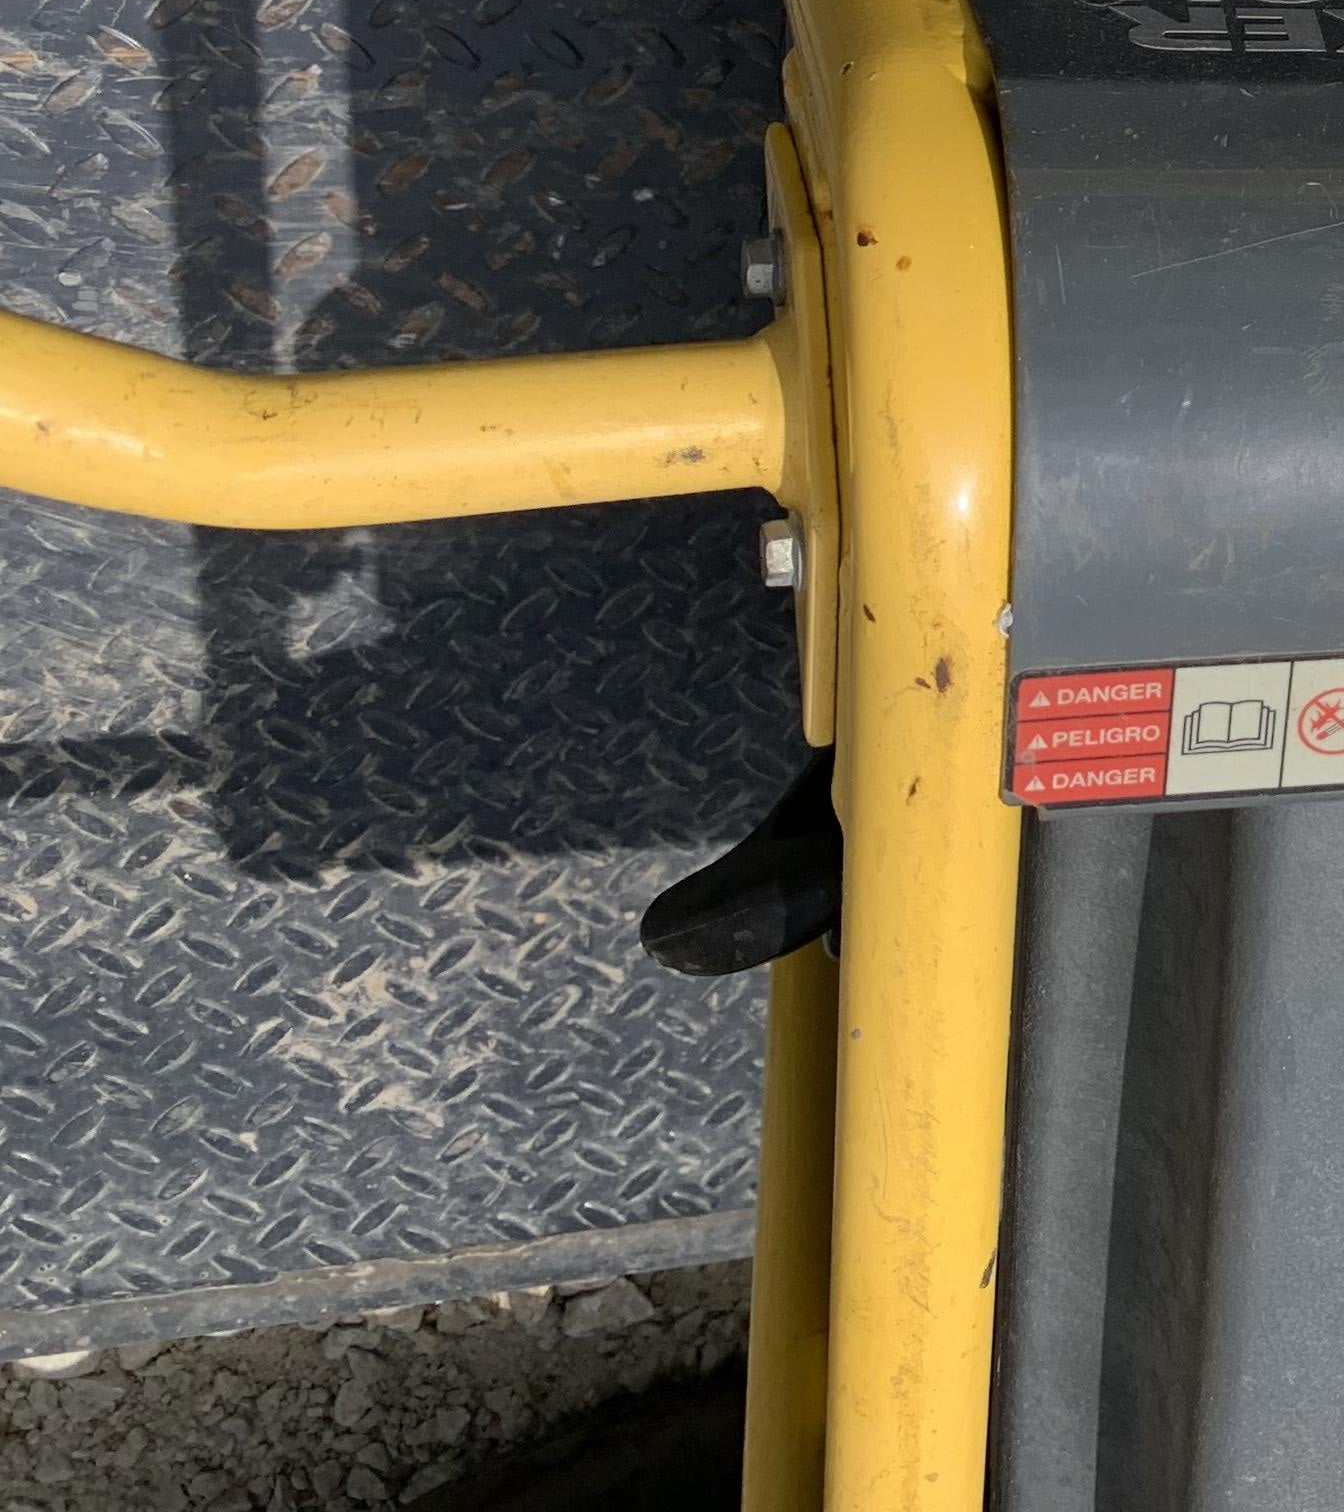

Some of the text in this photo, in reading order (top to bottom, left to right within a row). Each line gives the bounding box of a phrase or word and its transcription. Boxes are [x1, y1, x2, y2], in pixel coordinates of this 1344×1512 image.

[1056, 682, 1162, 707] DANGER
[1052, 724, 1161, 749] PELIGRO
[1050, 766, 1157, 791] DANGER
